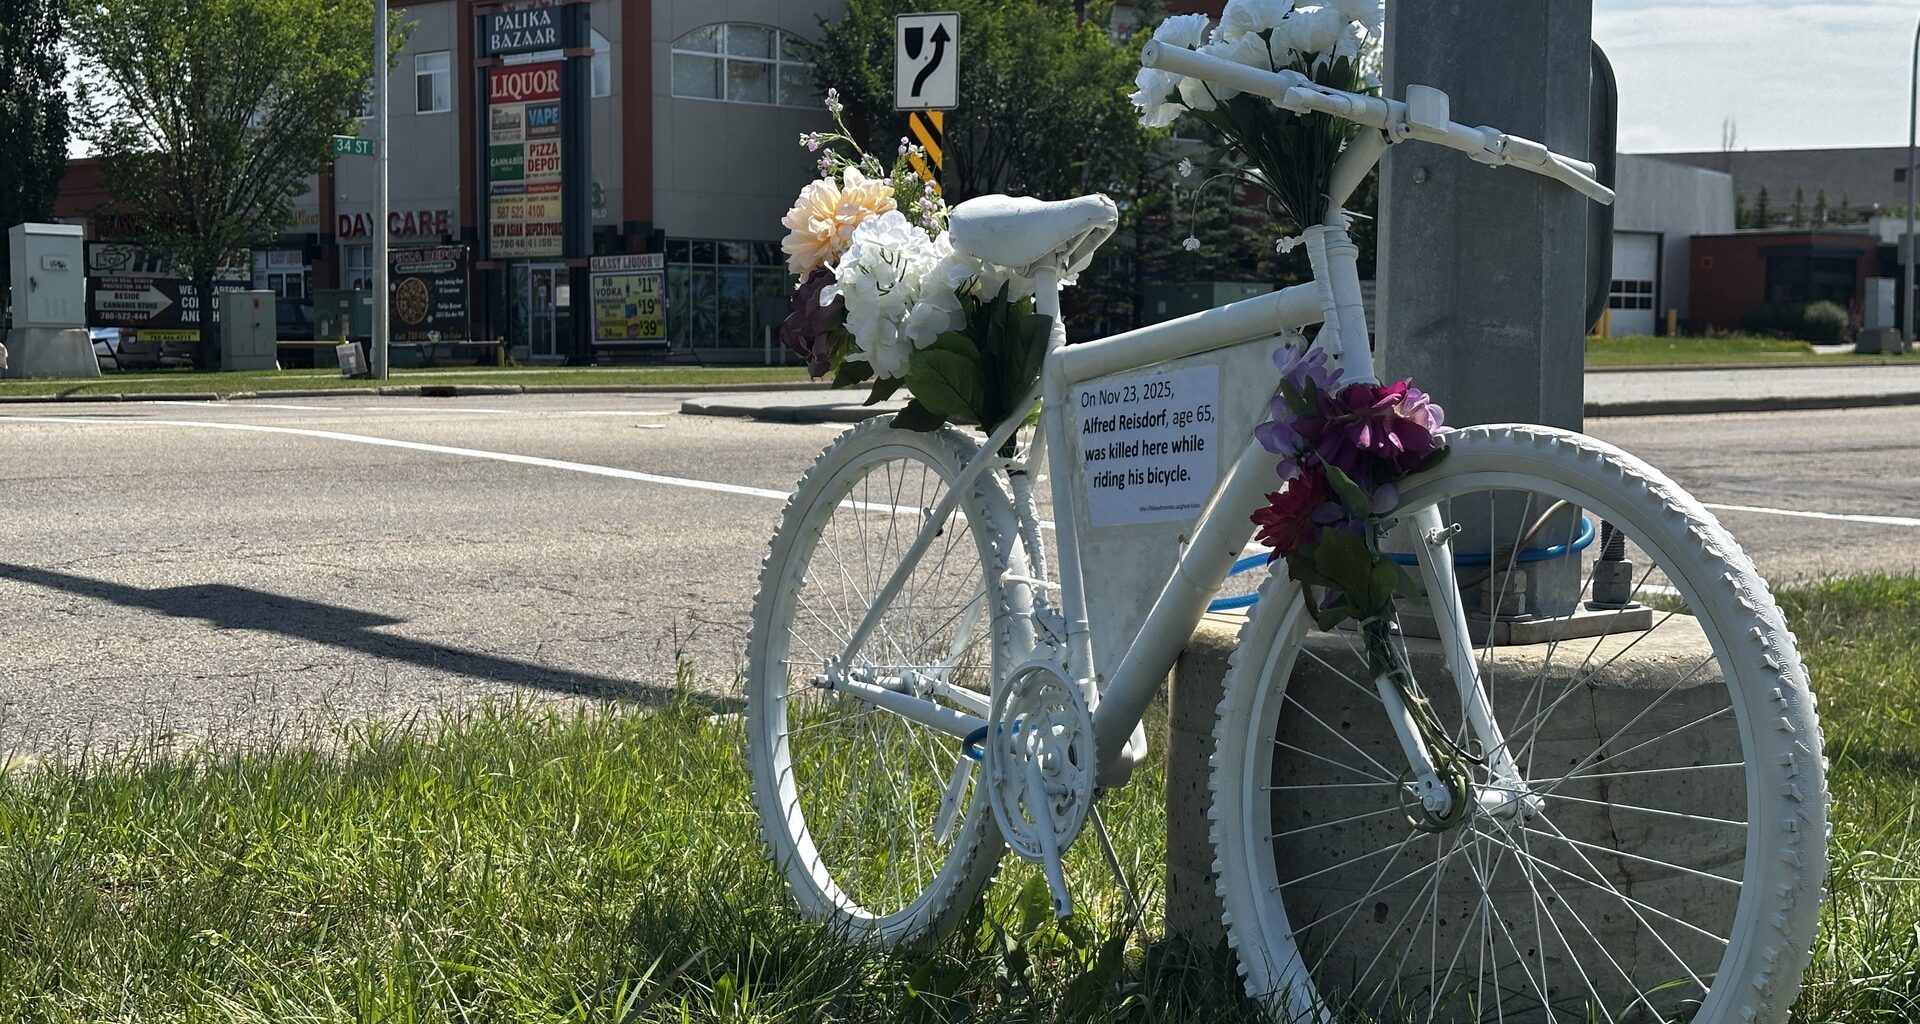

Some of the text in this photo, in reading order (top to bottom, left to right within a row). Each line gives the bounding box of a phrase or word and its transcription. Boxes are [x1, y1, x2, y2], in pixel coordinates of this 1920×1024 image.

[495, 10, 551, 31] PALIKA
[491, 28, 556, 50] BAZAAR
[491, 70, 560, 100] LIQUOR
[528, 107, 559, 126] VAPE
[337, 139, 369, 154] 34 ST
[528, 157, 560, 172] DEPOT
[497, 206, 509, 219] 587
[528, 204, 545, 218] 4100
[339, 210, 448, 237] DAY CARE
[506, 223, 523, 237] ASIAN
[526, 223, 543, 236] SUPER
[424, 248, 462, 261] DEPOT
[592, 257, 621, 270] GLASSY
[623, 256, 653, 268] LIQUOR
[114, 292, 140, 300] BESIDE
[596, 287, 623, 297] VODKA
[137, 302, 158, 310] STORE
[1081, 381, 1175, 408] On Nov 23, 2025,
[1083, 405, 1215, 435] Alfred Reisdorf, age 65,
[1085, 435, 1205, 461] was killed here while
[1093, 465, 1191, 490] riding his bicycle.
